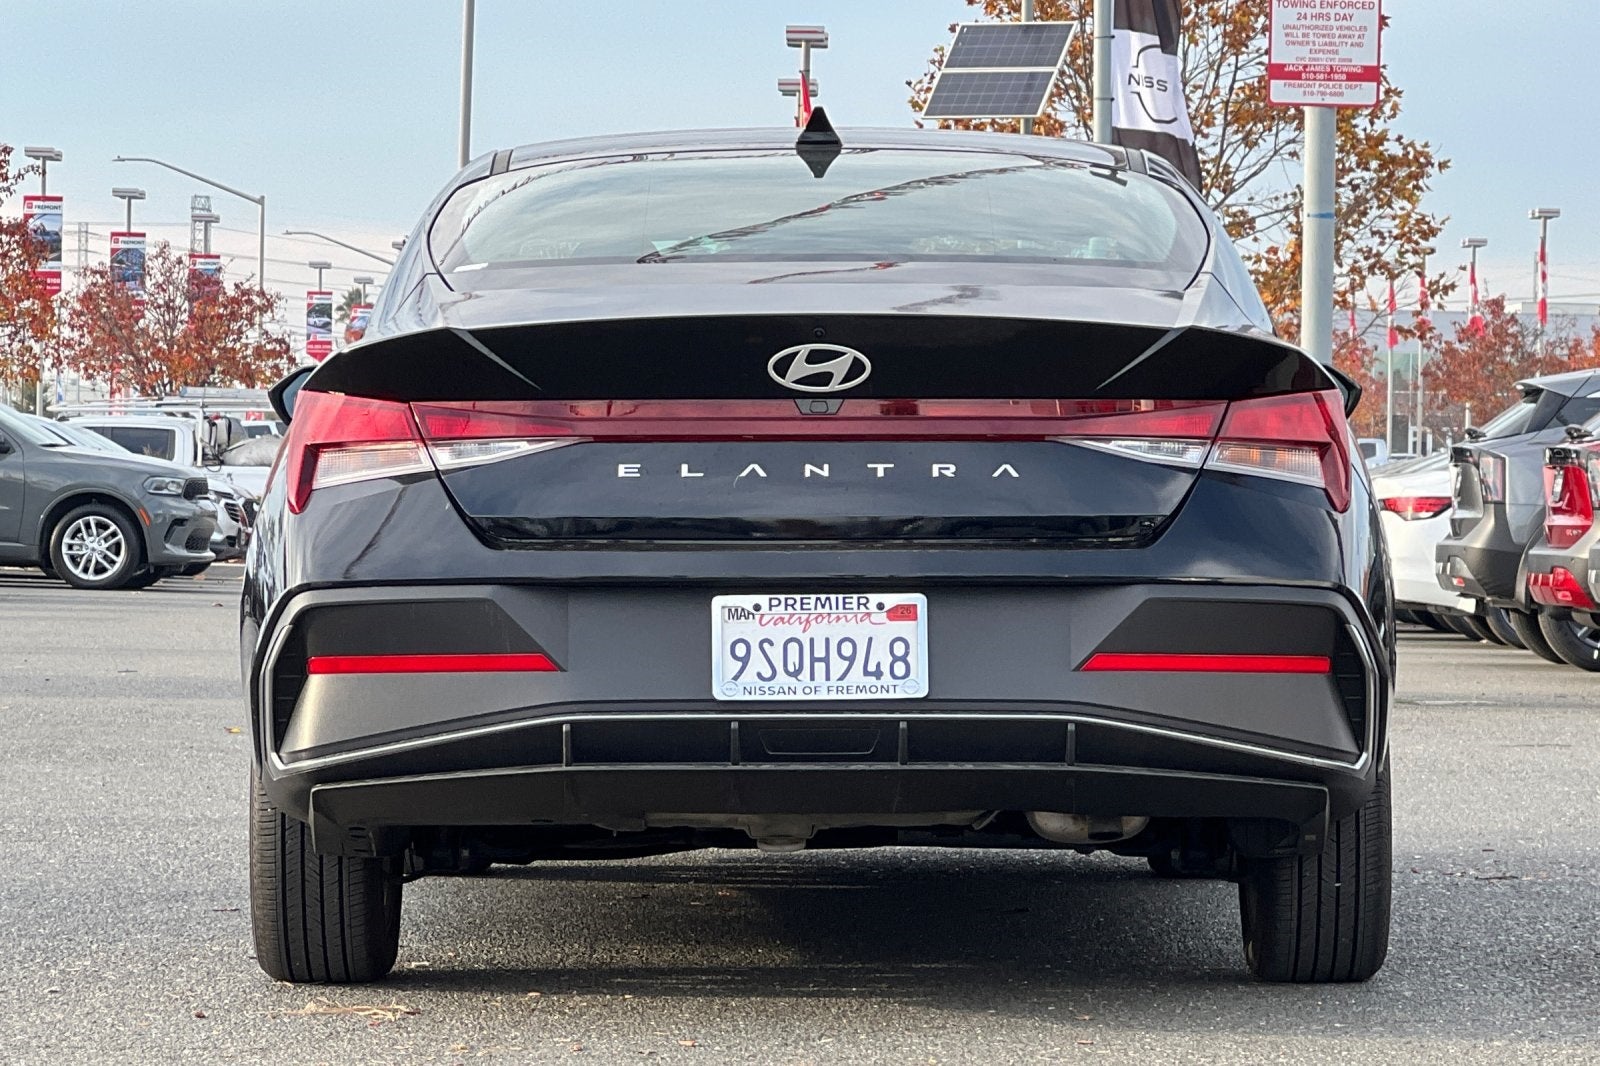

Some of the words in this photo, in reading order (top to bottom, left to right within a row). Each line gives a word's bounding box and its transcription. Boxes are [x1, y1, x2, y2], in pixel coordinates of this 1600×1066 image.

[1276, 0, 1316, 9] TOWING
[1319, 0, 1375, 10] ENFORCED
[1296, 12, 1308, 21] 24
[1310, 13, 1331, 21] HRS
[1334, 13, 1354, 22] DAY
[1284, 64, 1304, 72] JACK
[616, 463, 1020, 478] ELANTRA
[768, 595, 871, 612] PREMIER
[899, 606, 912, 615] 26
[729, 636, 912, 683] 9SQH948
[742, 685, 798, 697] NISSAN
[802, 685, 824, 696] OF
[826, 683, 899, 696] FREMONT
